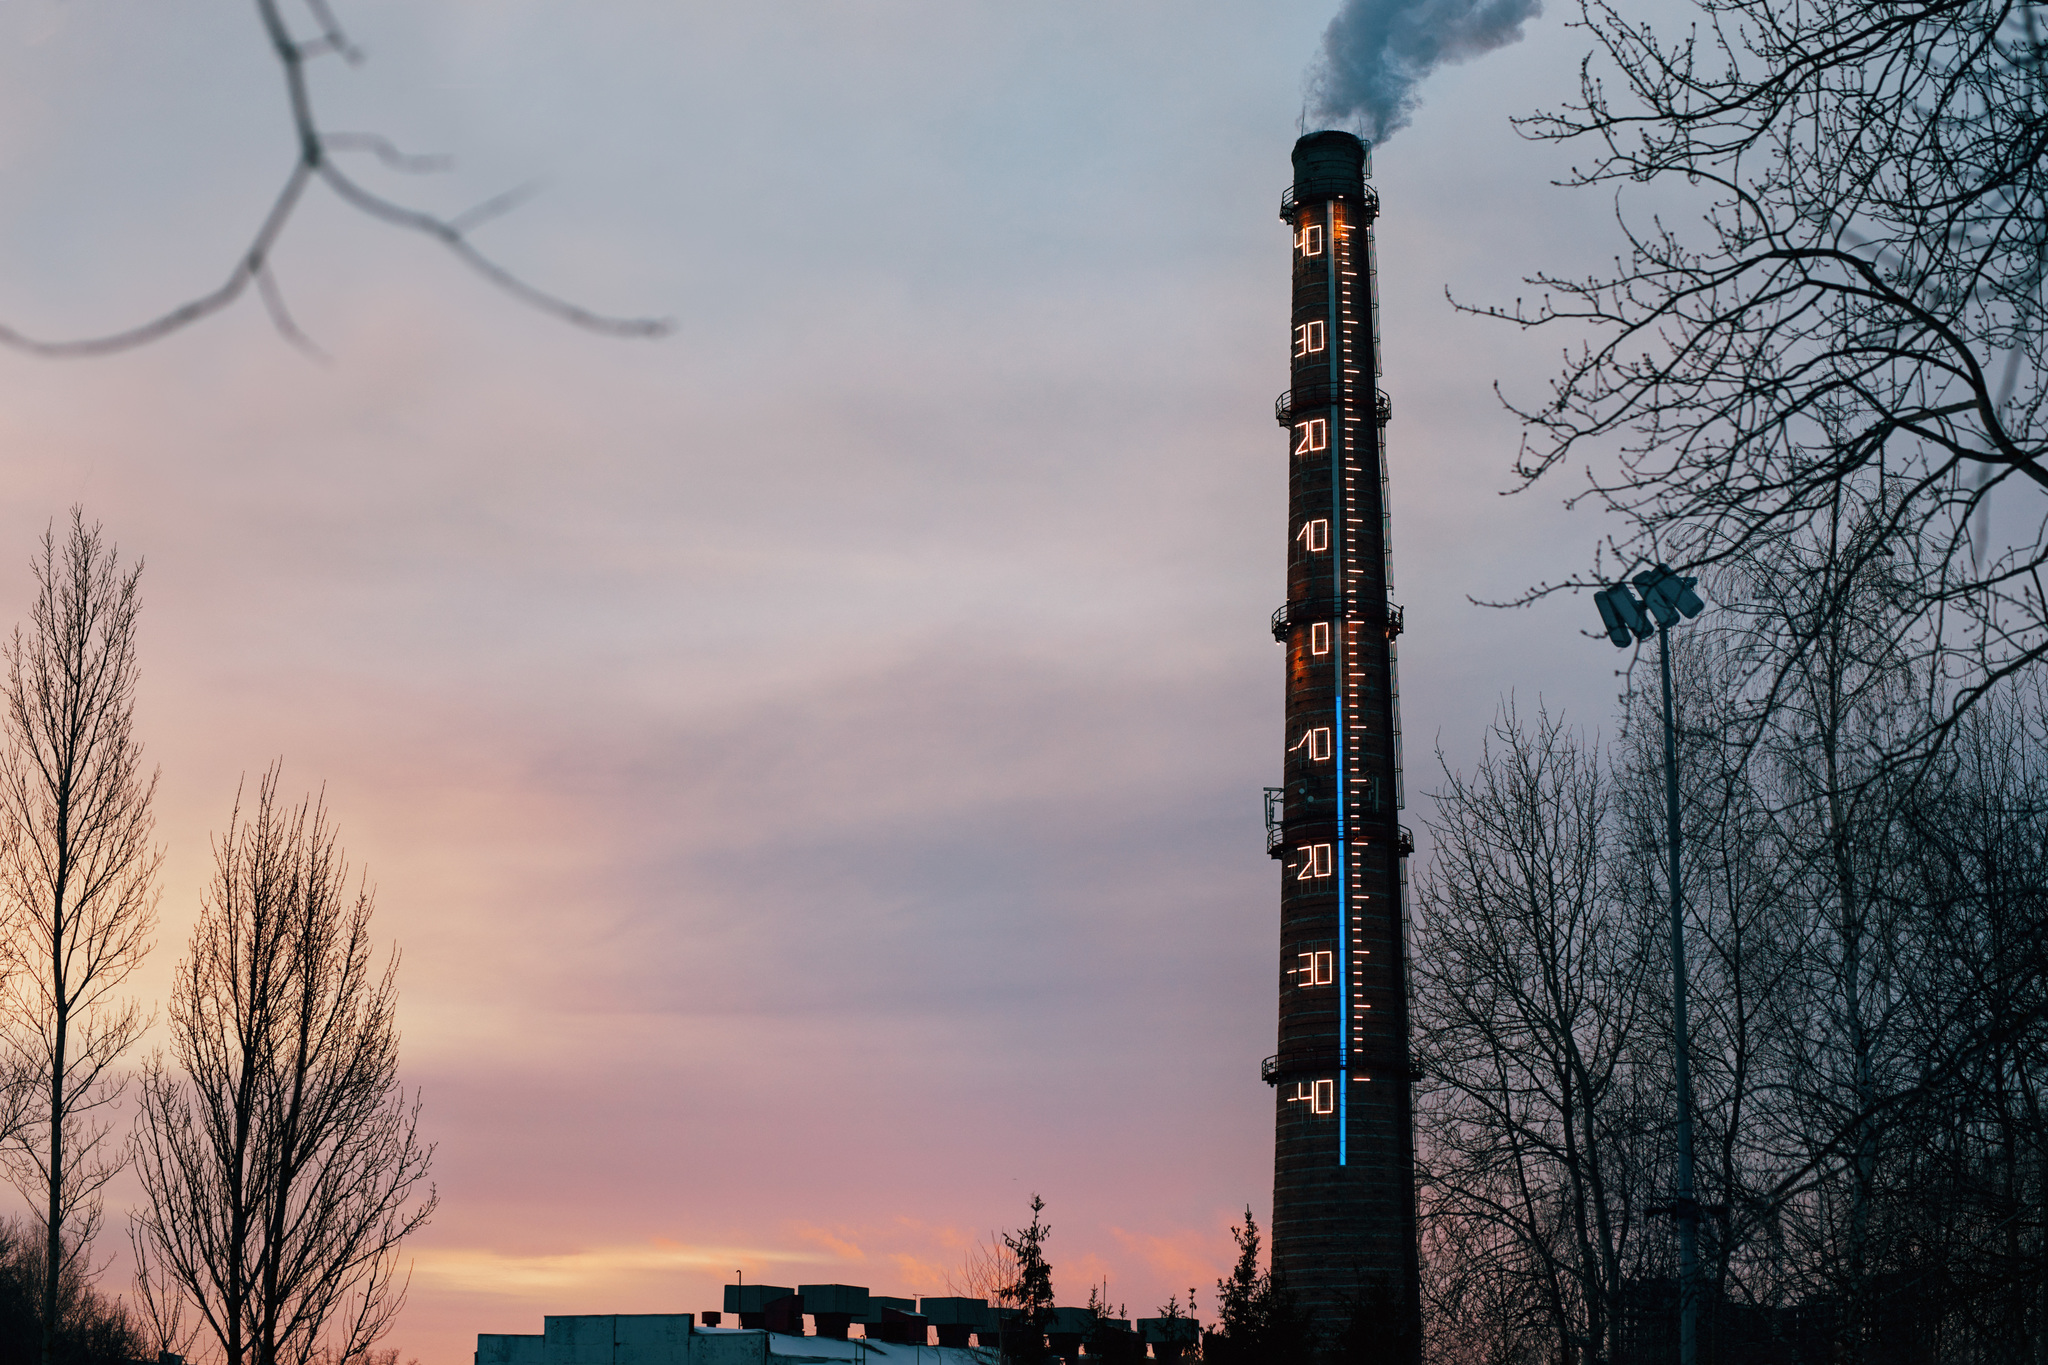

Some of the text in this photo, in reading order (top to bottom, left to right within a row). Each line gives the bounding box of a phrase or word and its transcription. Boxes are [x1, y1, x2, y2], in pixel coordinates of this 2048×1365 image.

[1293, 224, 1323, 258] 40
[1294, 319, 1325, 358] 30
[1294, 418, 1327, 456] 20
[1295, 518, 1328, 553] 10
[1311, 621, 1330, 657] 0
[1288, 726, 1331, 762] -10
[1287, 843, 1332, 881] -20
[1286, 950, 1333, 988] -30
[1286, 1078, 1334, 1115] -40
